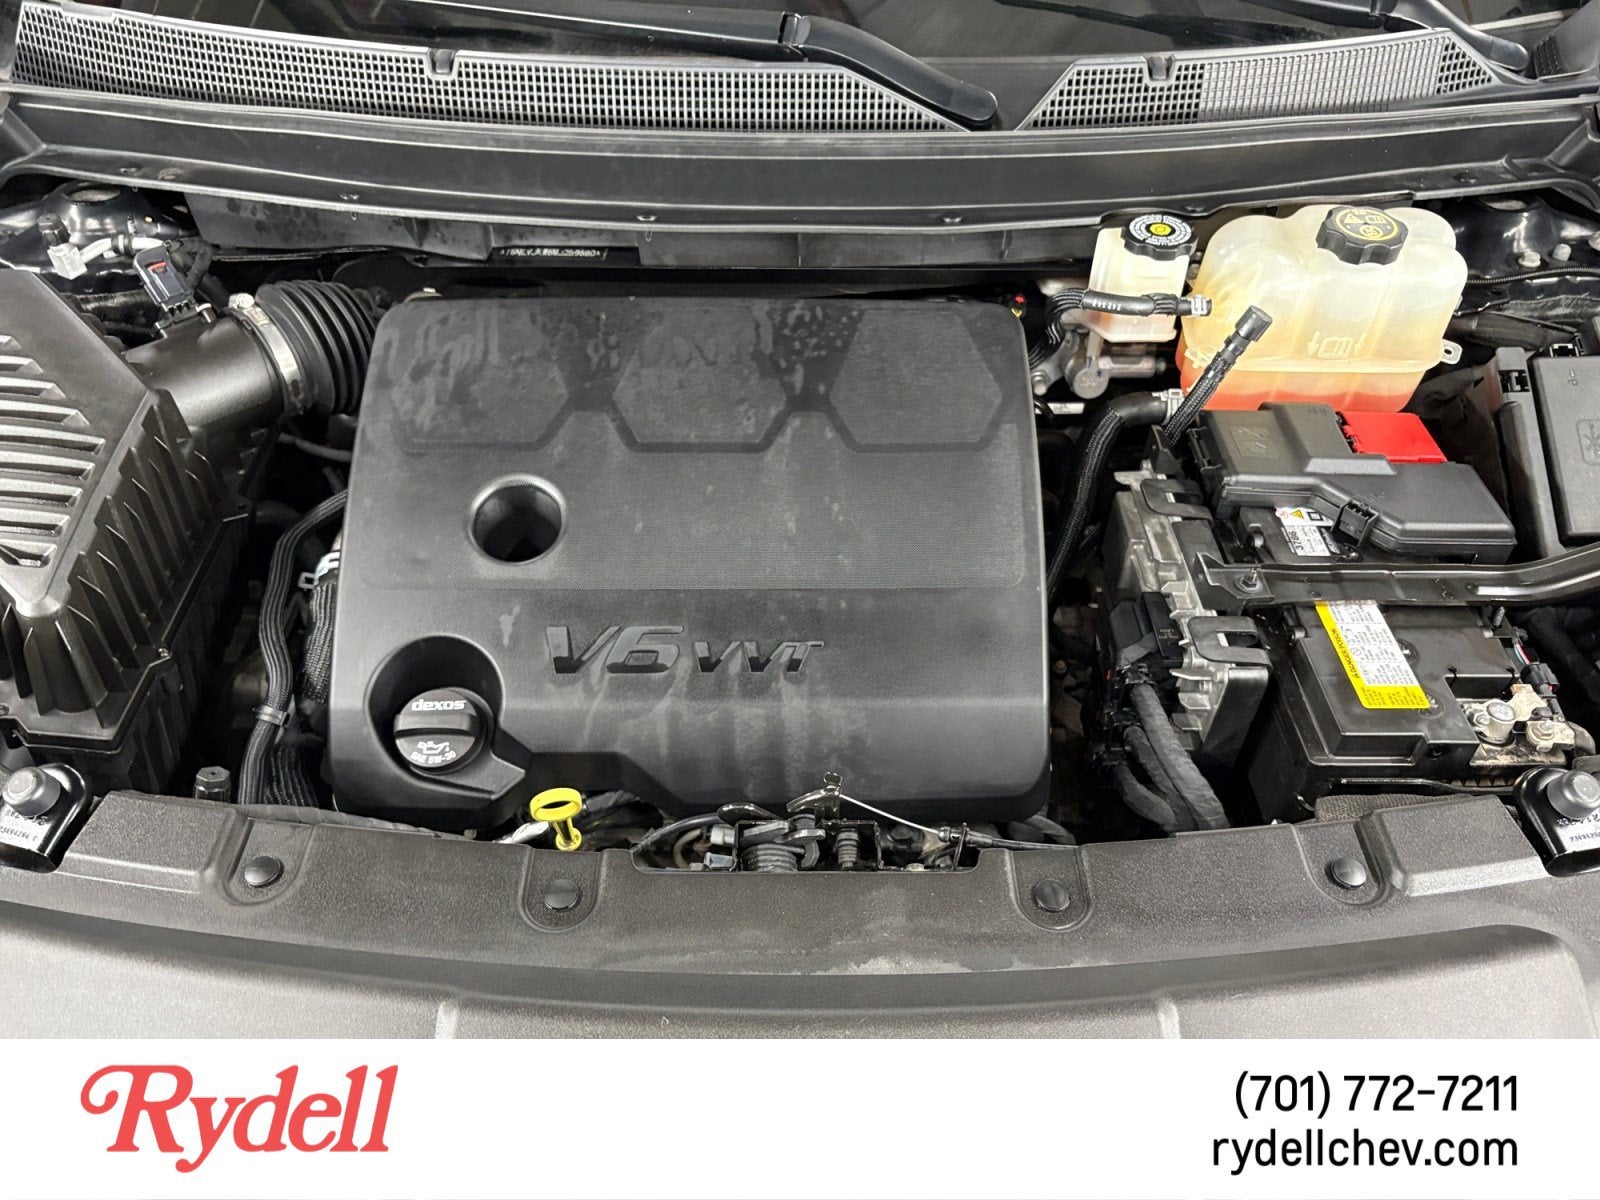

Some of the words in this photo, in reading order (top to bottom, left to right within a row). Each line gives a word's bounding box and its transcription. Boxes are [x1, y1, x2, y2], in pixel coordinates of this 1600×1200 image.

[545, 625, 684, 674] V6
[694, 640, 825, 673] VVT
[411, 698, 467, 712] dexos
[428, 750, 457, 764] 5W-30
